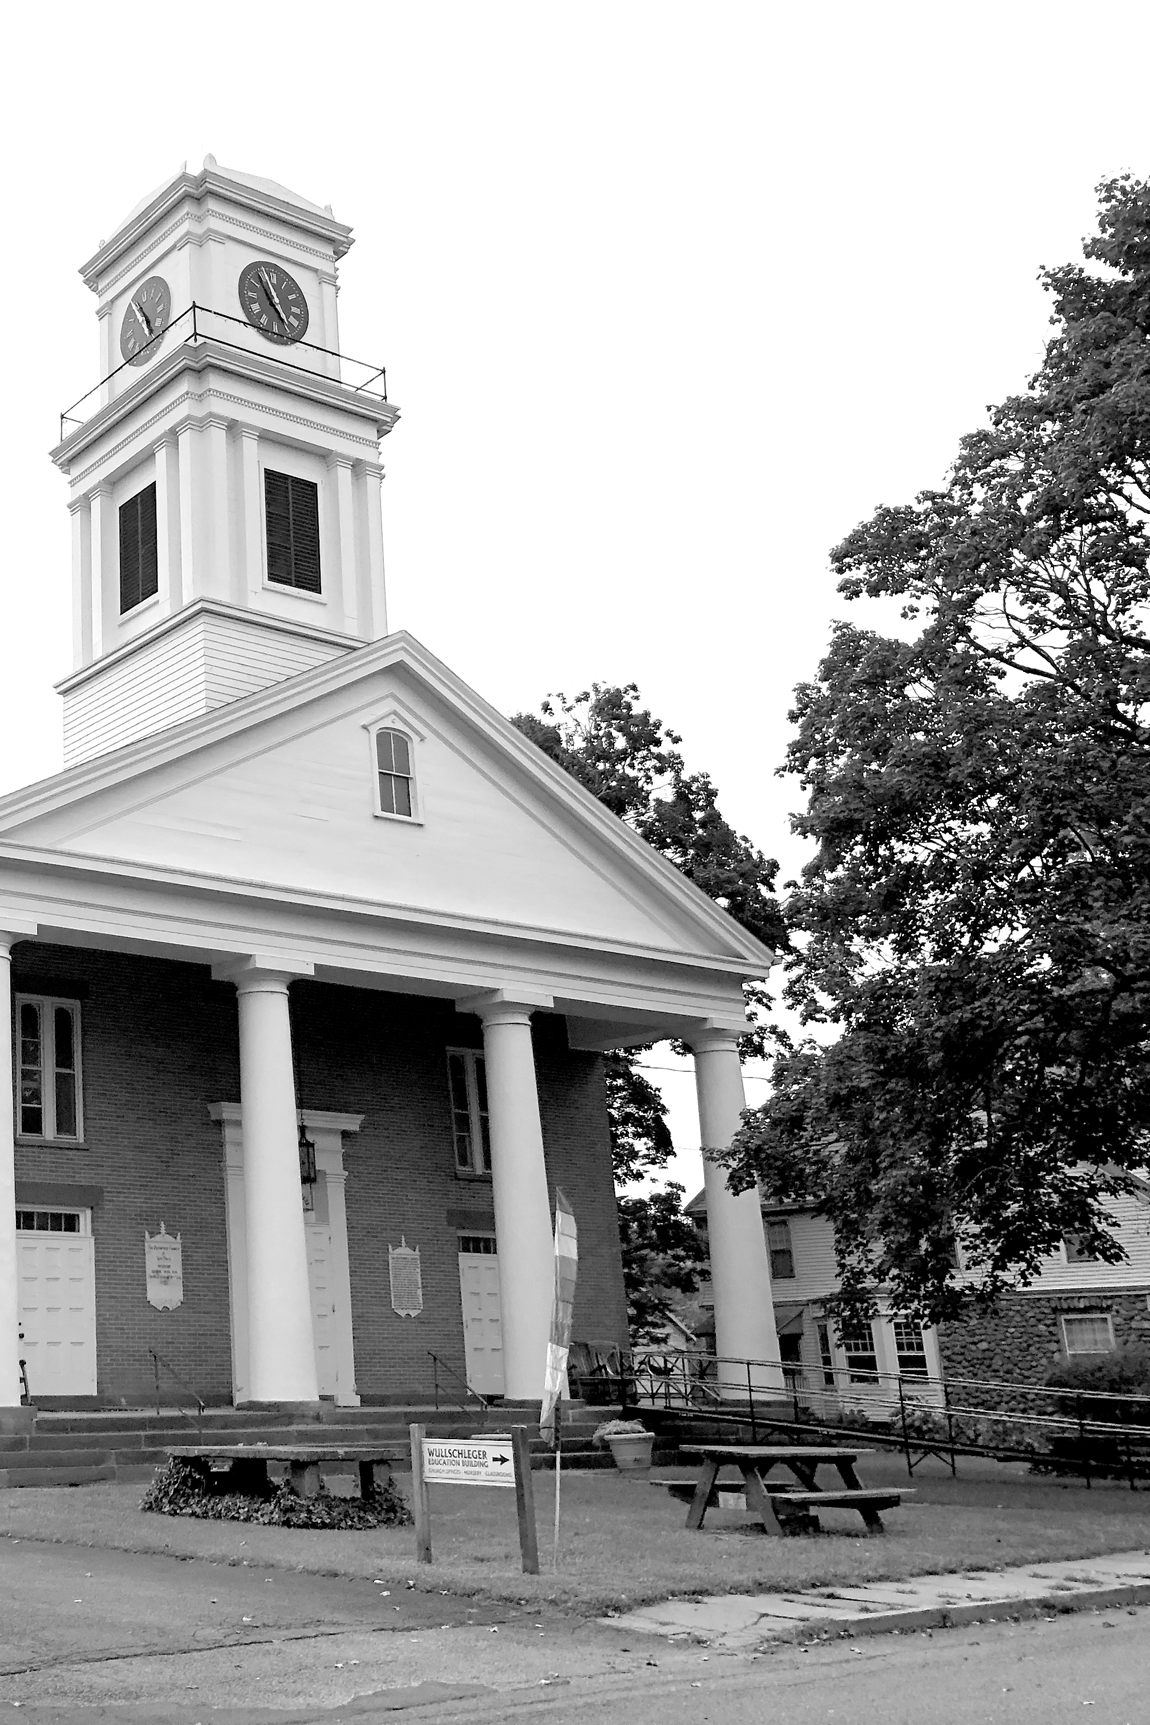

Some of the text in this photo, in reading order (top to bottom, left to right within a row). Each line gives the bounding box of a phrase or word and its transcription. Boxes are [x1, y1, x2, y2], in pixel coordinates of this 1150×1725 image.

[427, 1447, 488, 1460] WULLSCHLEGER
[428, 1458, 489, 1468] EDUCATION BUILDING
